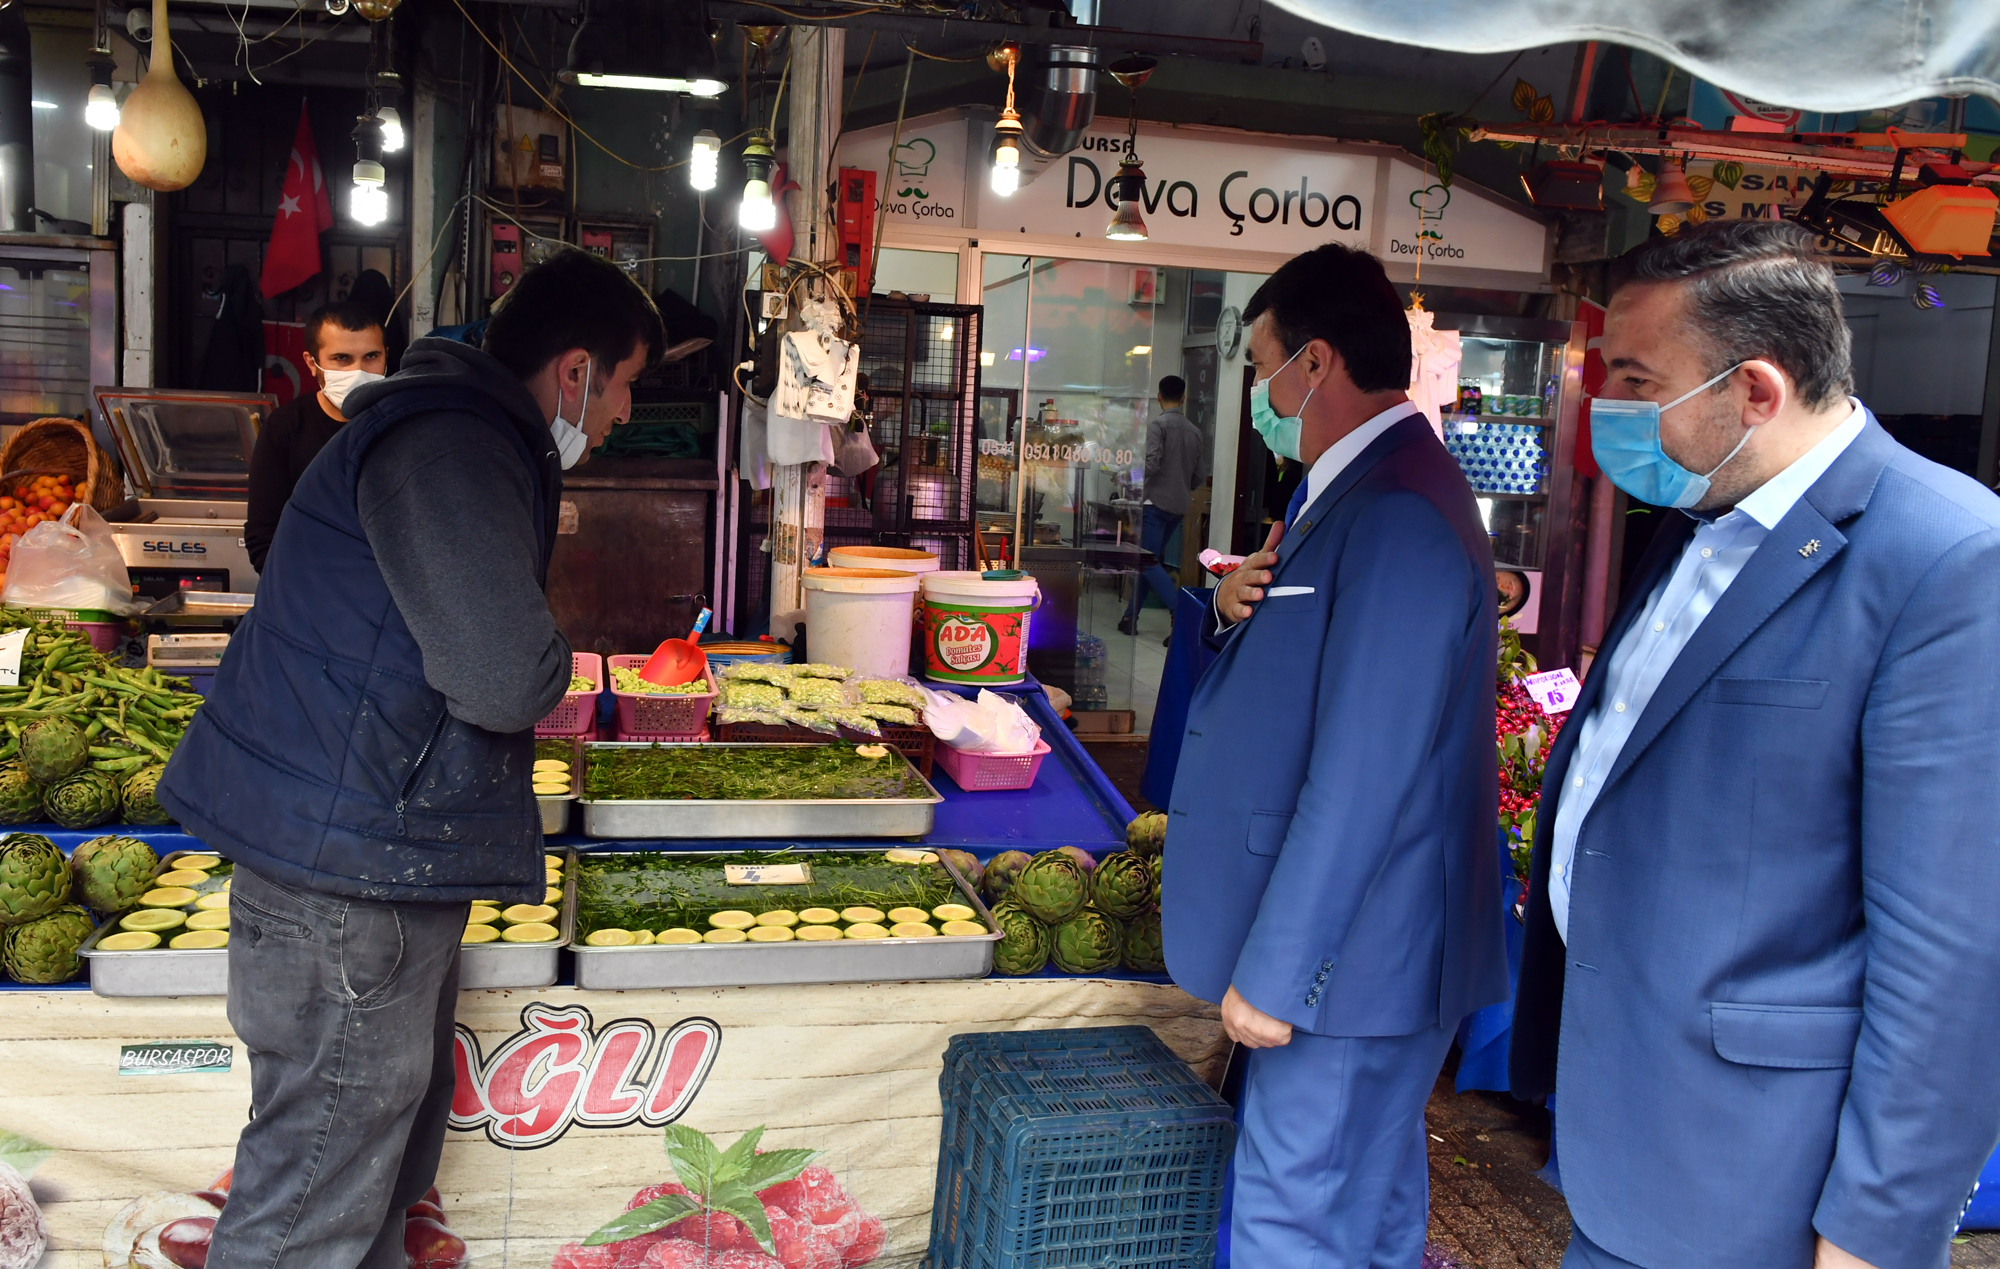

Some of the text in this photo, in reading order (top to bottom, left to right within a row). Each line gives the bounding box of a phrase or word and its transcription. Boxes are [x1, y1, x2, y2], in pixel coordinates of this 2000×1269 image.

[912, 201, 954, 219] Çorba
[1219, 170, 1361, 236] Çorba
[1390, 239, 1464, 260] Deva Çorba
[1094, 448, 1112, 464] 30
[1115, 449, 1133, 465] 80
[143, 541, 207, 554] SELES
[940, 625, 986, 642] ADA
[945, 644, 983, 656] Domates
[1547, 688, 1564, 706] 15
[121, 1048, 231, 1067] BURSASPOR
